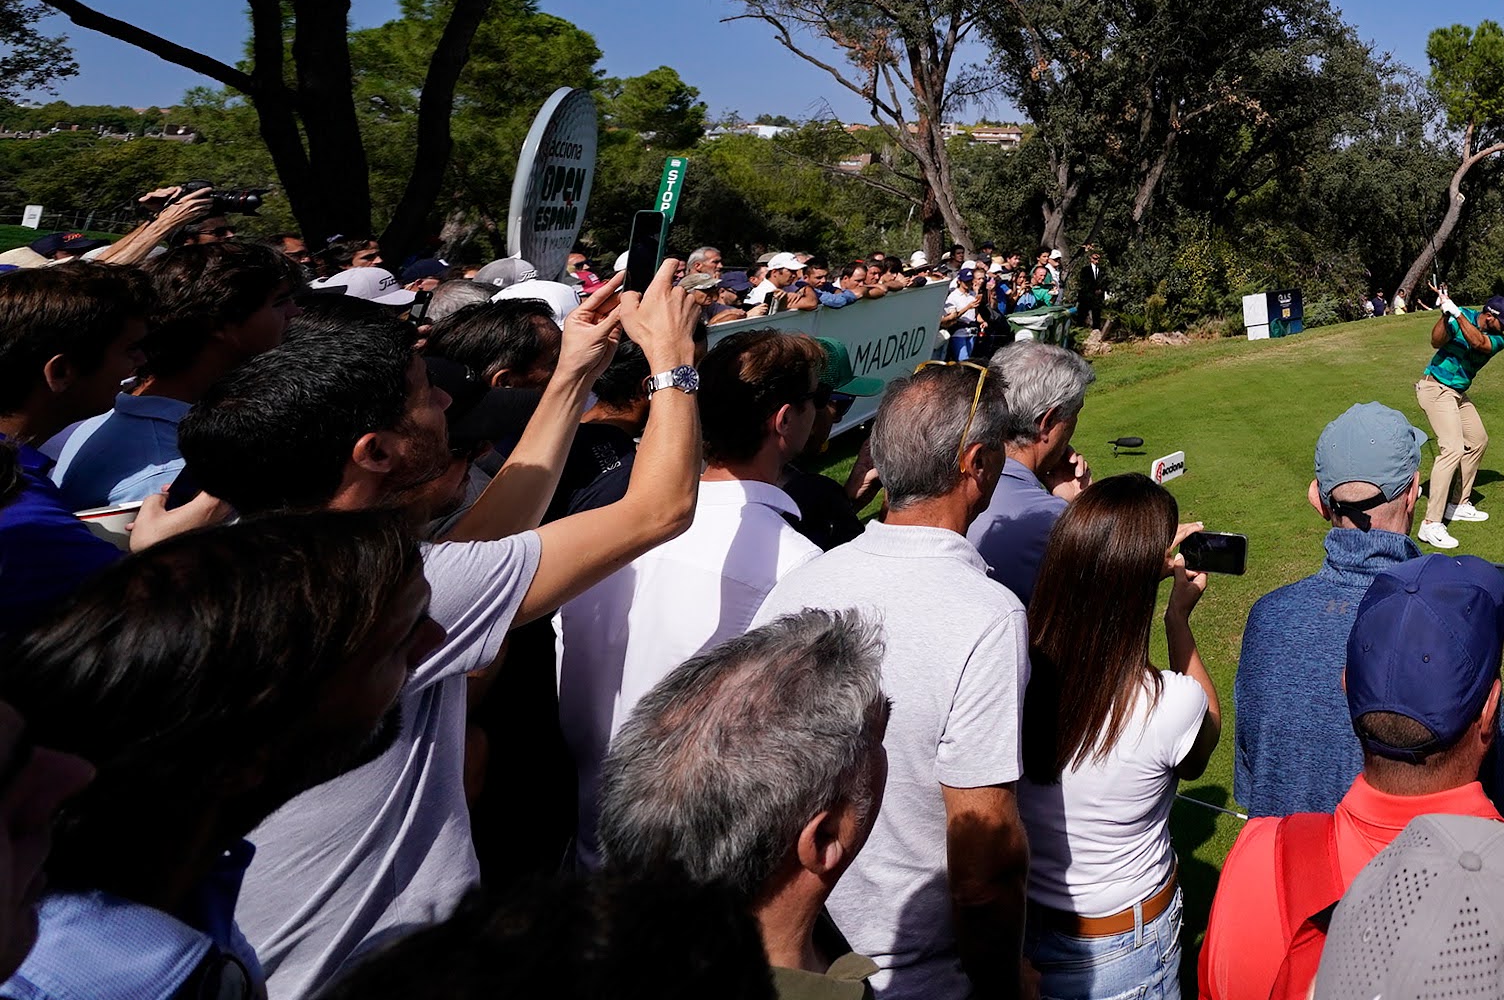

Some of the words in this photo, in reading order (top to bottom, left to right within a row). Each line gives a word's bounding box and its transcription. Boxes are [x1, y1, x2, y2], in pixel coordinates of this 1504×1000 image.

[550, 136, 583, 161] acciona
[541, 165, 587, 202] OPEN
[660, 169, 679, 212] STOP
[533, 202, 578, 233] ESPAÑA
[852, 325, 927, 377] MADRID
